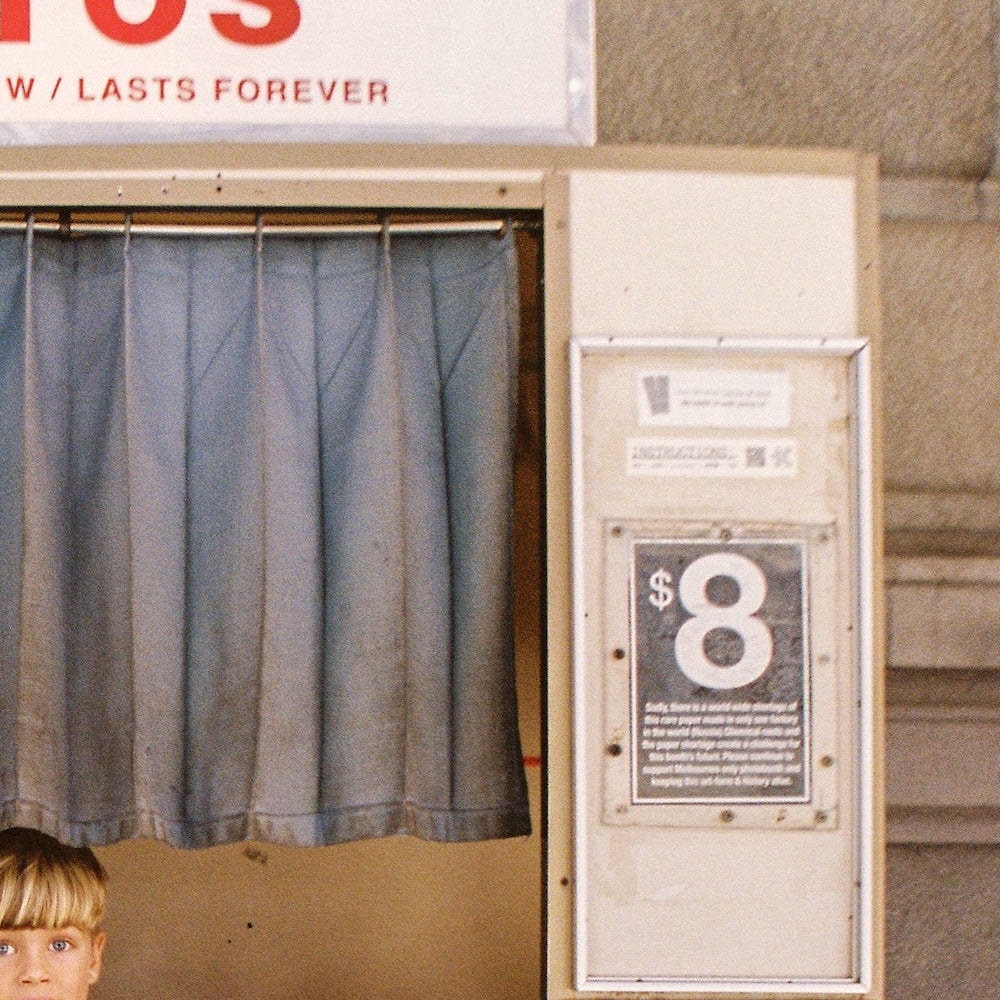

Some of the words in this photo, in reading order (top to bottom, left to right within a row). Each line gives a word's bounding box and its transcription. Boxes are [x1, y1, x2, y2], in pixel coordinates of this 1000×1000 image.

[51, 77, 63, 101] /
[78, 78, 197, 103] LASTS
[215, 79, 390, 105] FOREVER
[648, 551, 774, 690] $8
